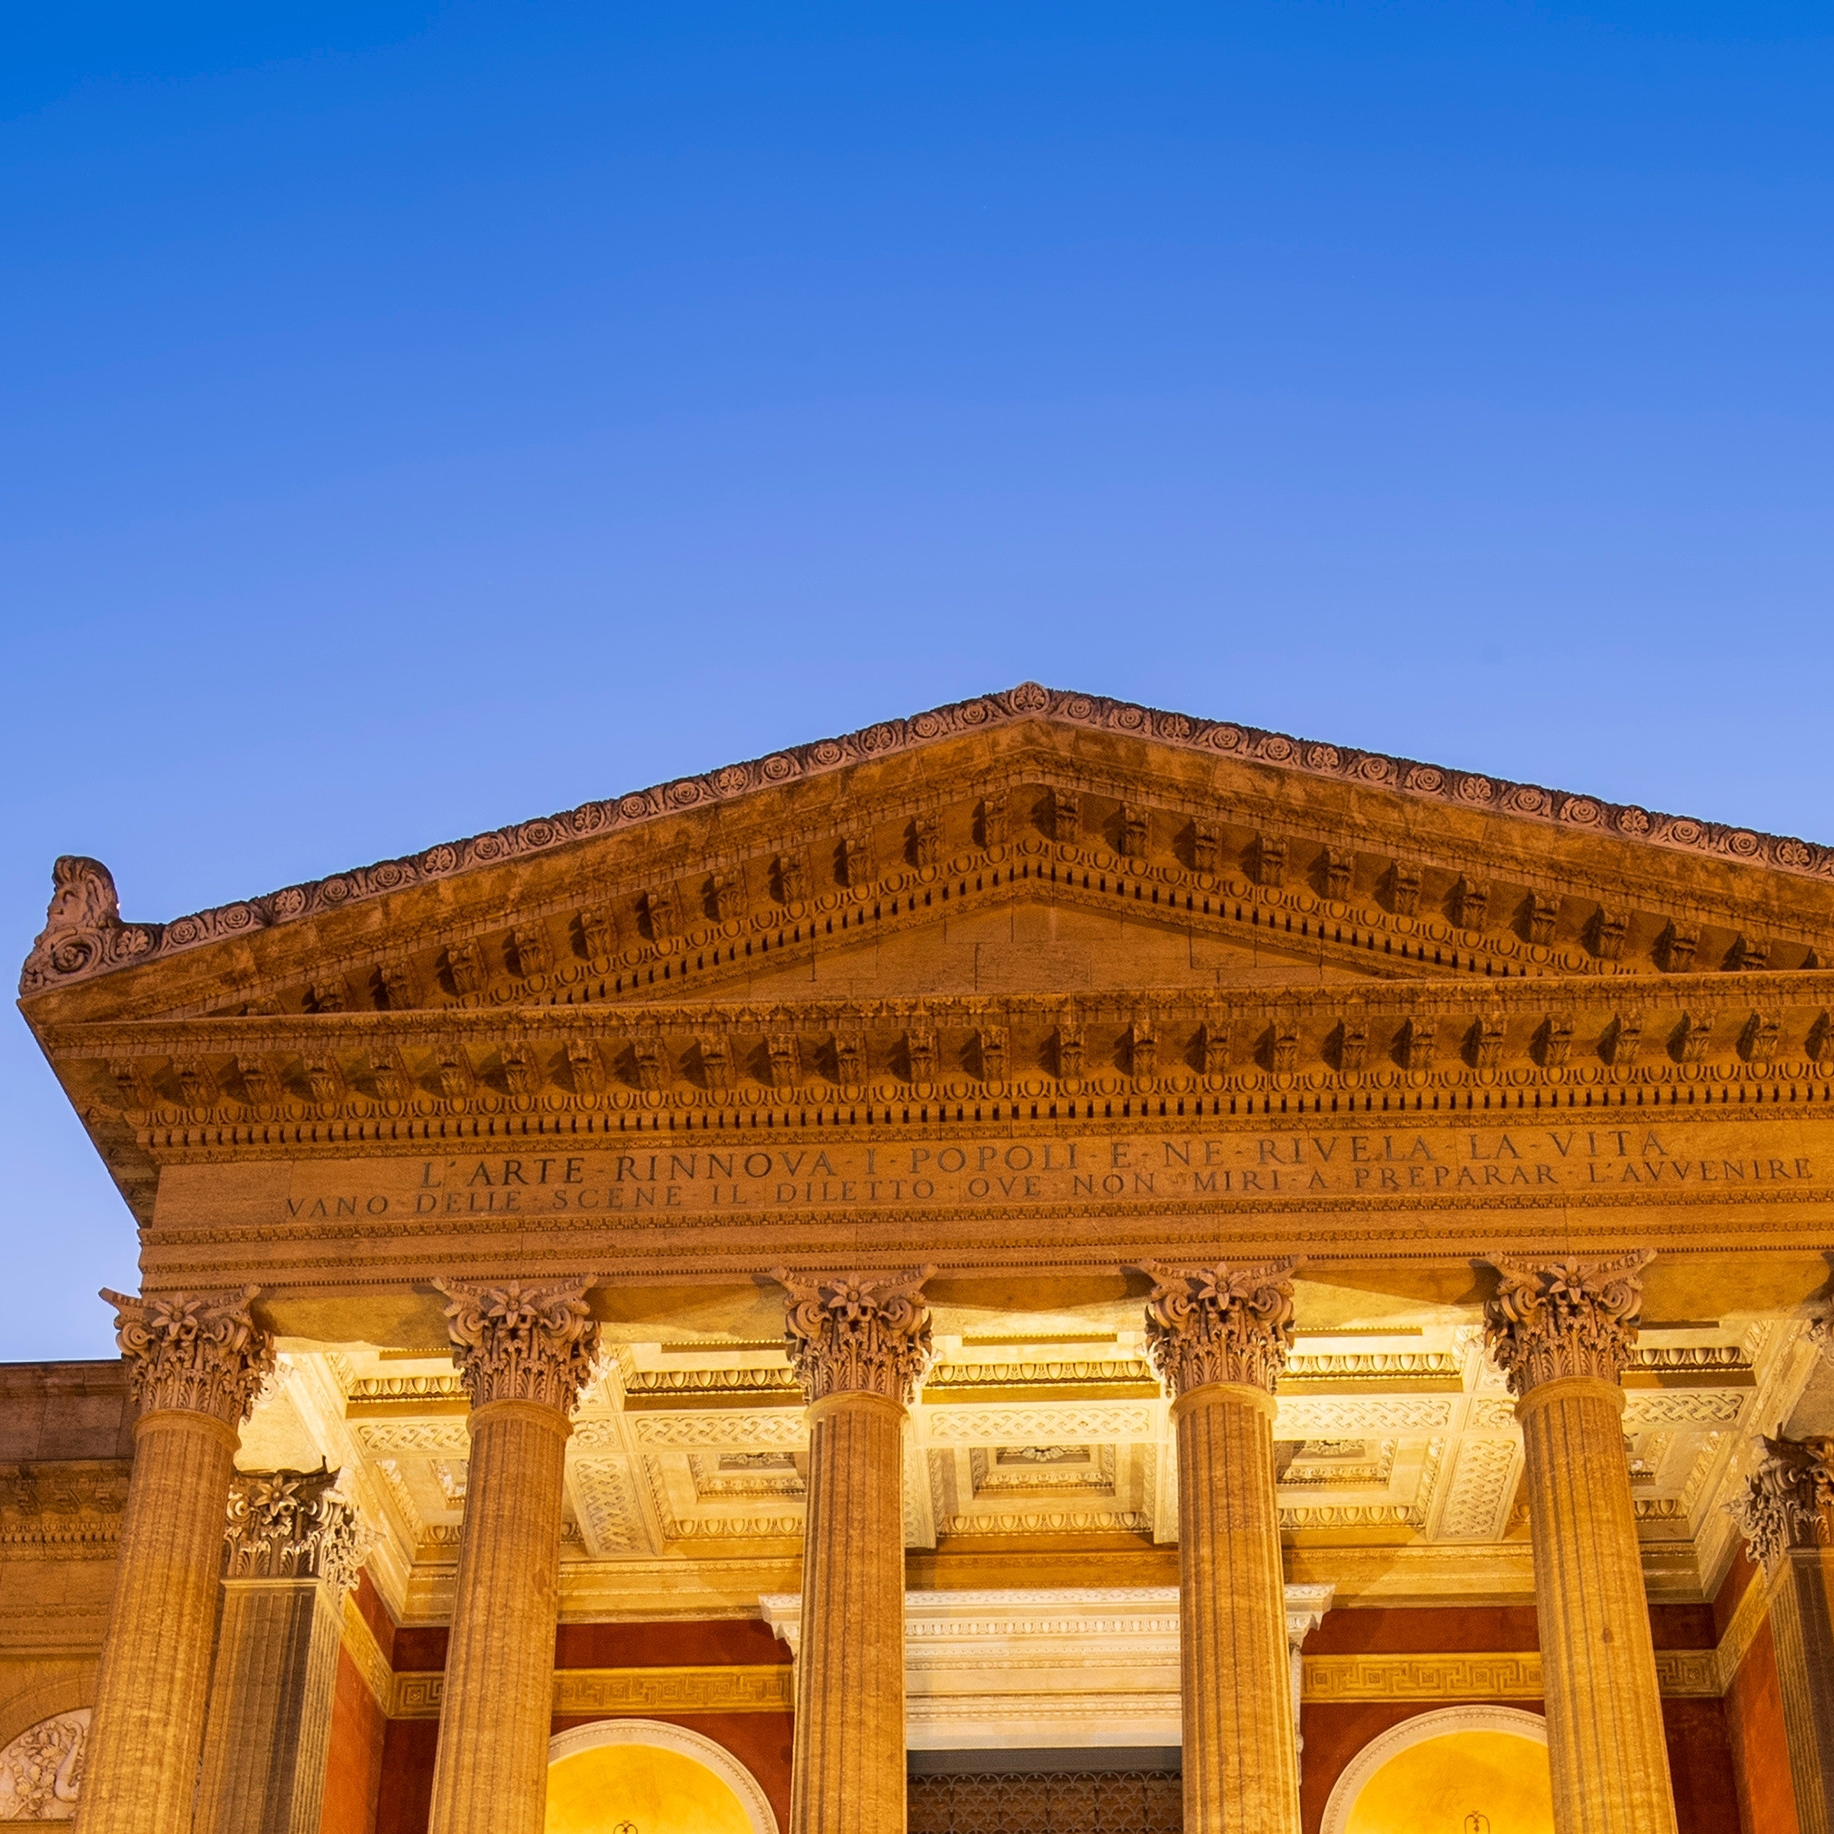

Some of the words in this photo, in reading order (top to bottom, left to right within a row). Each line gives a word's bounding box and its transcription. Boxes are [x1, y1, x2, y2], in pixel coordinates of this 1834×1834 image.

[617, 1151, 837, 1184] RINNOVA
[909, 1144, 1077, 1174] POPOLI
[1112, 1142, 1131, 1168] E
[1162, 1139, 1225, 1168] NE
[1257, 1135, 1436, 1165] RIVELA
[1469, 1133, 1524, 1160] LA
[1546, 1130, 1669, 1158] VITA
[286, 1195, 389, 1218] VANO
[551, 1186, 683, 1210] SCENE
[712, 1184, 747, 1205] IL
[776, 1178, 935, 1203] DILETTO
[967, 1175, 1041, 1198] OVE
[1072, 1172, 1155, 1197] NON
[1193, 1170, 1281, 1193] MIRI
[1354, 1163, 1559, 1189] PREPARAR
